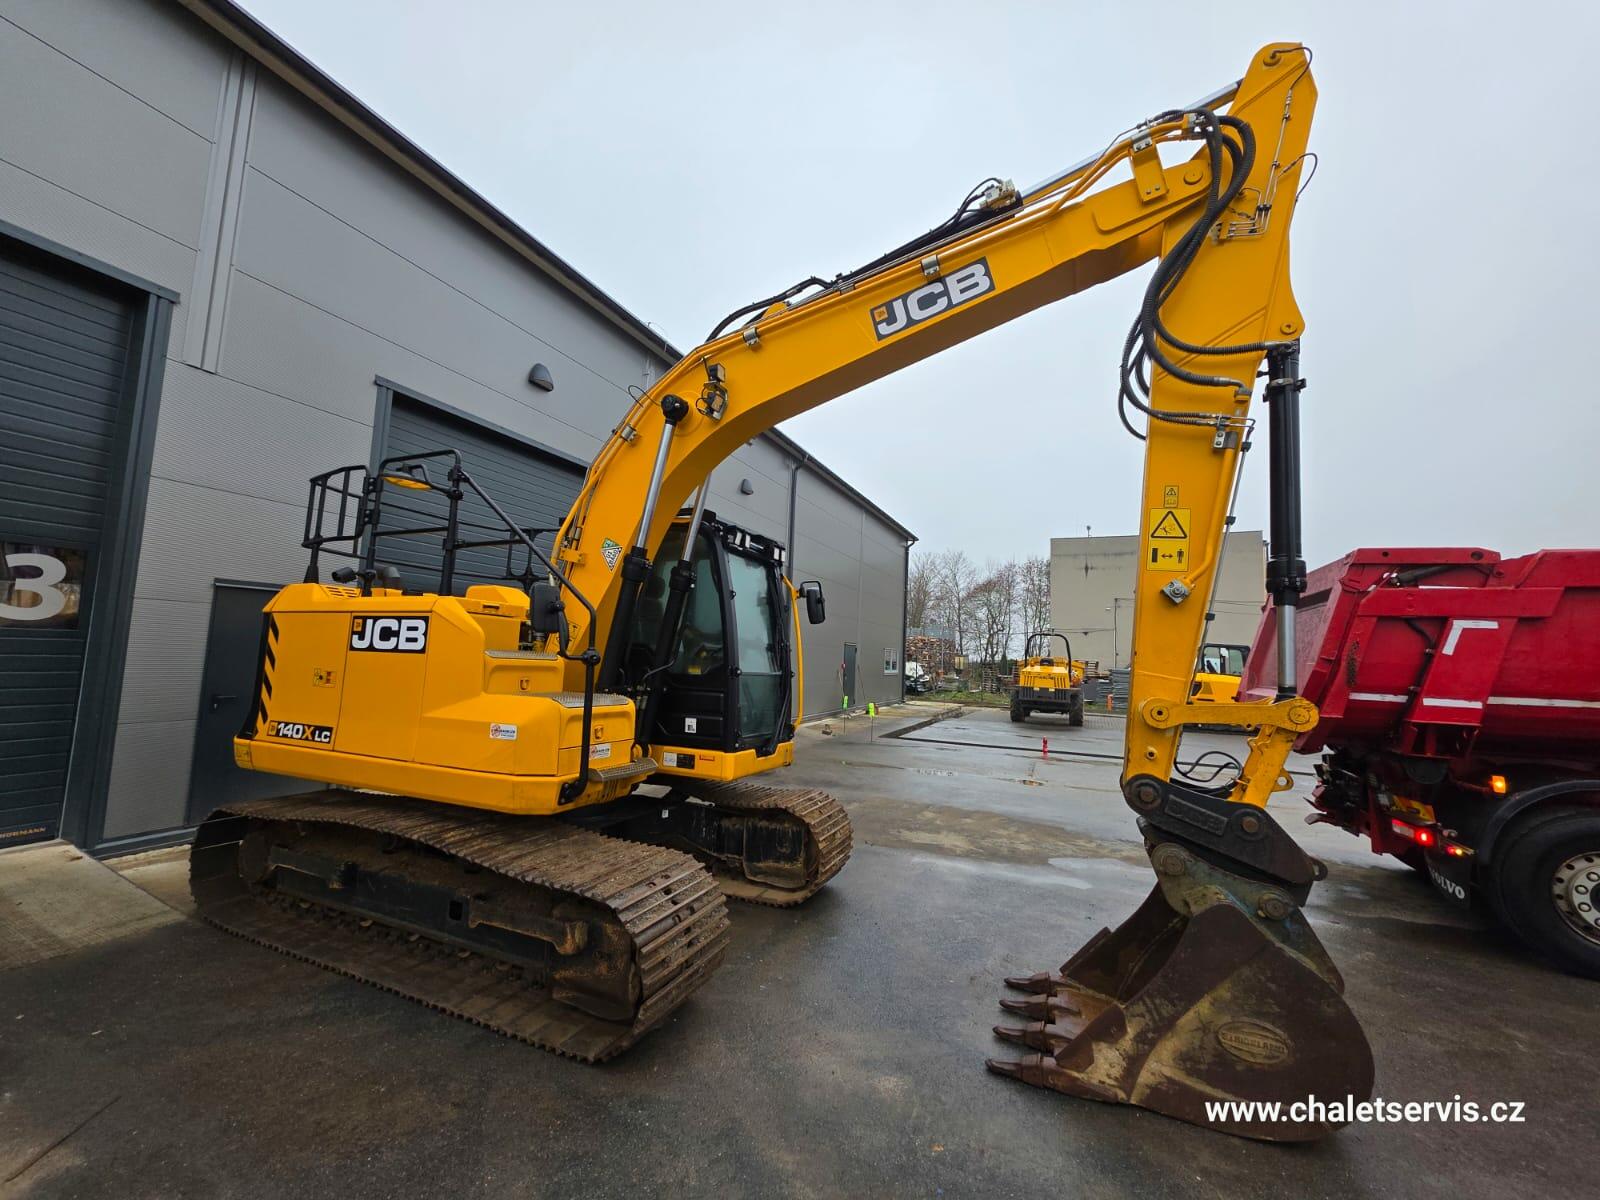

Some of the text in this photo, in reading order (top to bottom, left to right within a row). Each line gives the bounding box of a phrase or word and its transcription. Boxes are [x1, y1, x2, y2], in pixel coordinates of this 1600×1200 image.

[877, 263, 991, 336] JCB
[0, 553, 67, 620] 3
[351, 618, 427, 651] JCB
[314, 730, 331, 743] LC
